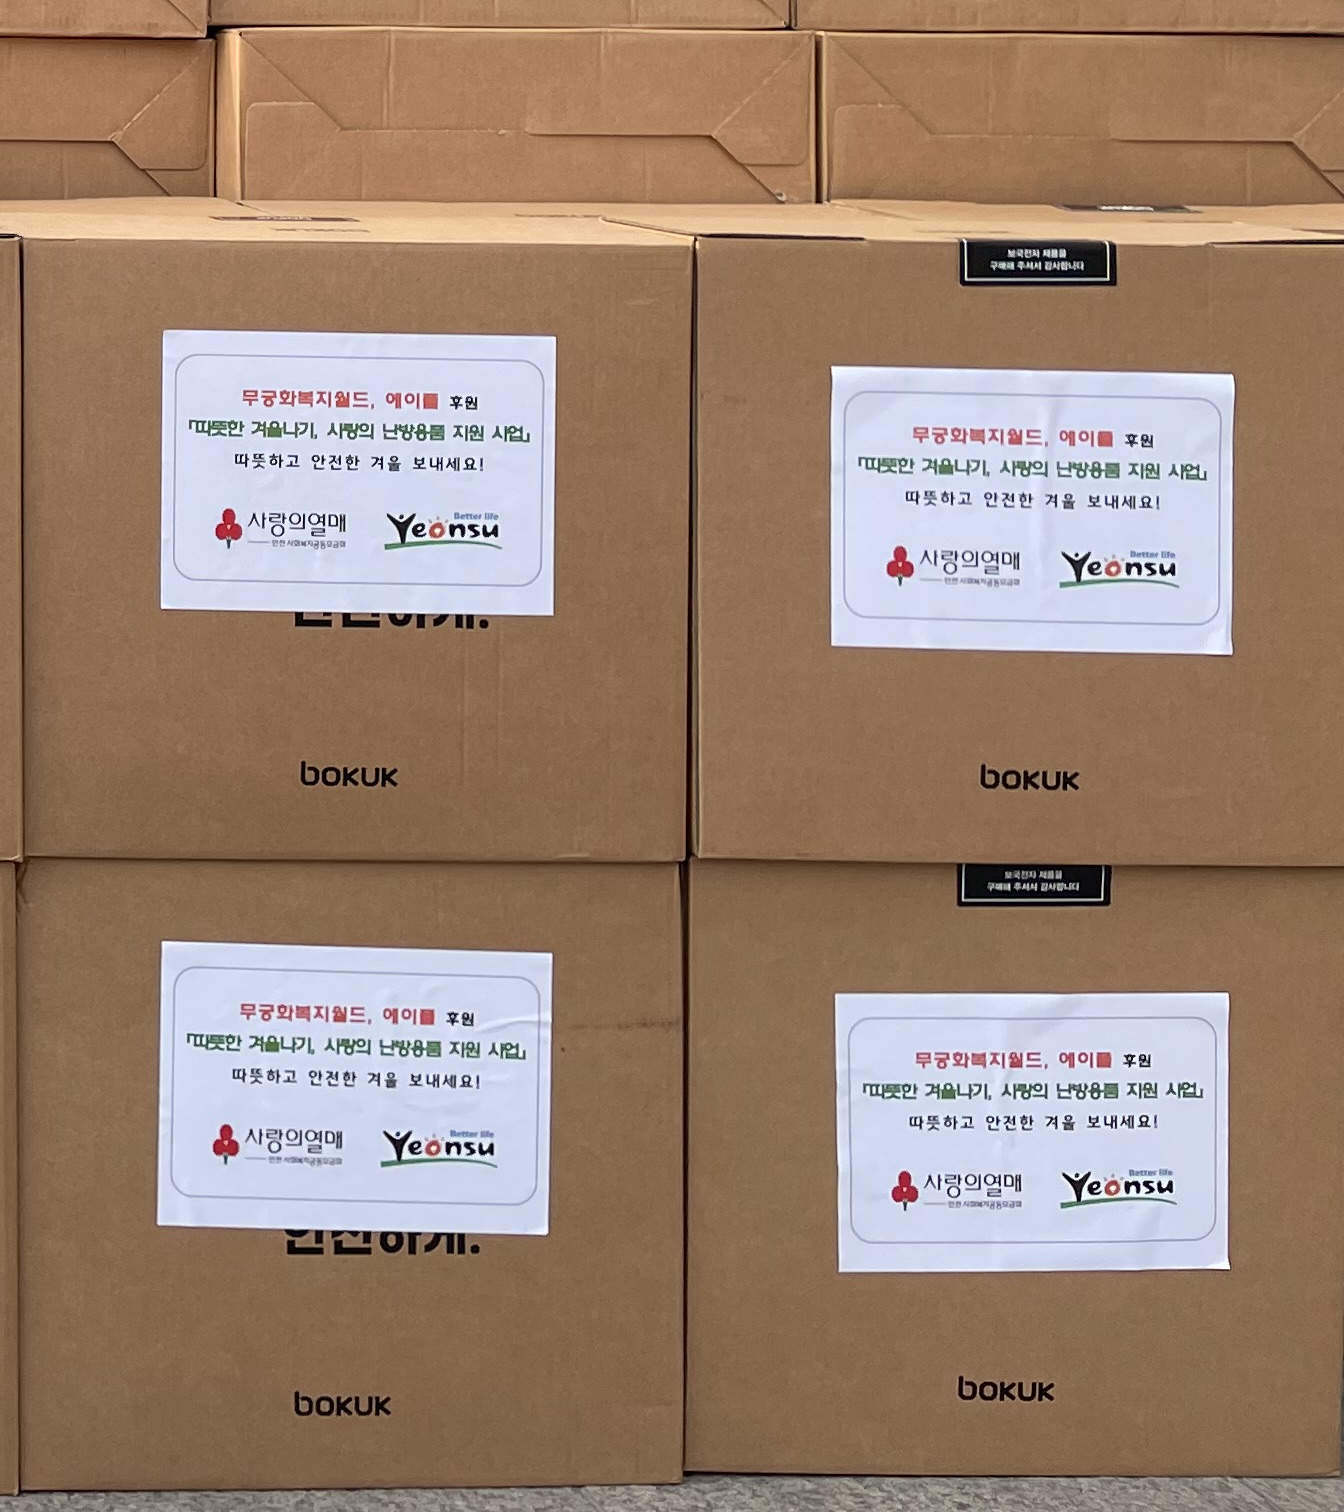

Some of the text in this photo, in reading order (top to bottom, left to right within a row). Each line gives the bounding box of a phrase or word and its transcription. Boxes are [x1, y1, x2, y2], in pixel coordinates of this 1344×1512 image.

[242, 390, 374, 410] 무궁화복지월드,
[450, 395, 478, 410] 후원
[235, 453, 483, 472] 따뜻하고 안전한 겨울 보내세요!
[905, 491, 1160, 510] 따뜻하고 안전한 겨울 보내세요!
[248, 512, 346, 537] 사랑의열매
[386, 512, 498, 548] Yeonsu
[920, 550, 1020, 575] 사랑의열매
[1063, 550, 1175, 586] Yeonsu
[916, 1052, 1048, 1070] 무궁화복지월드,
[1123, 1054, 1151, 1068] 후원
[232, 1068, 480, 1089] 따뜻하고 안전한 겨울 보내세요!
[909, 1115, 1157, 1131] 따뜻하고 안전한 겨울 보내세요!
[245, 1128, 342, 1154] 사랑의열매
[384, 1130, 494, 1166] Yeonsu
[923, 1173, 1021, 1198] 사랑의열매
[1064, 1169, 1173, 1205] Yeonsu
